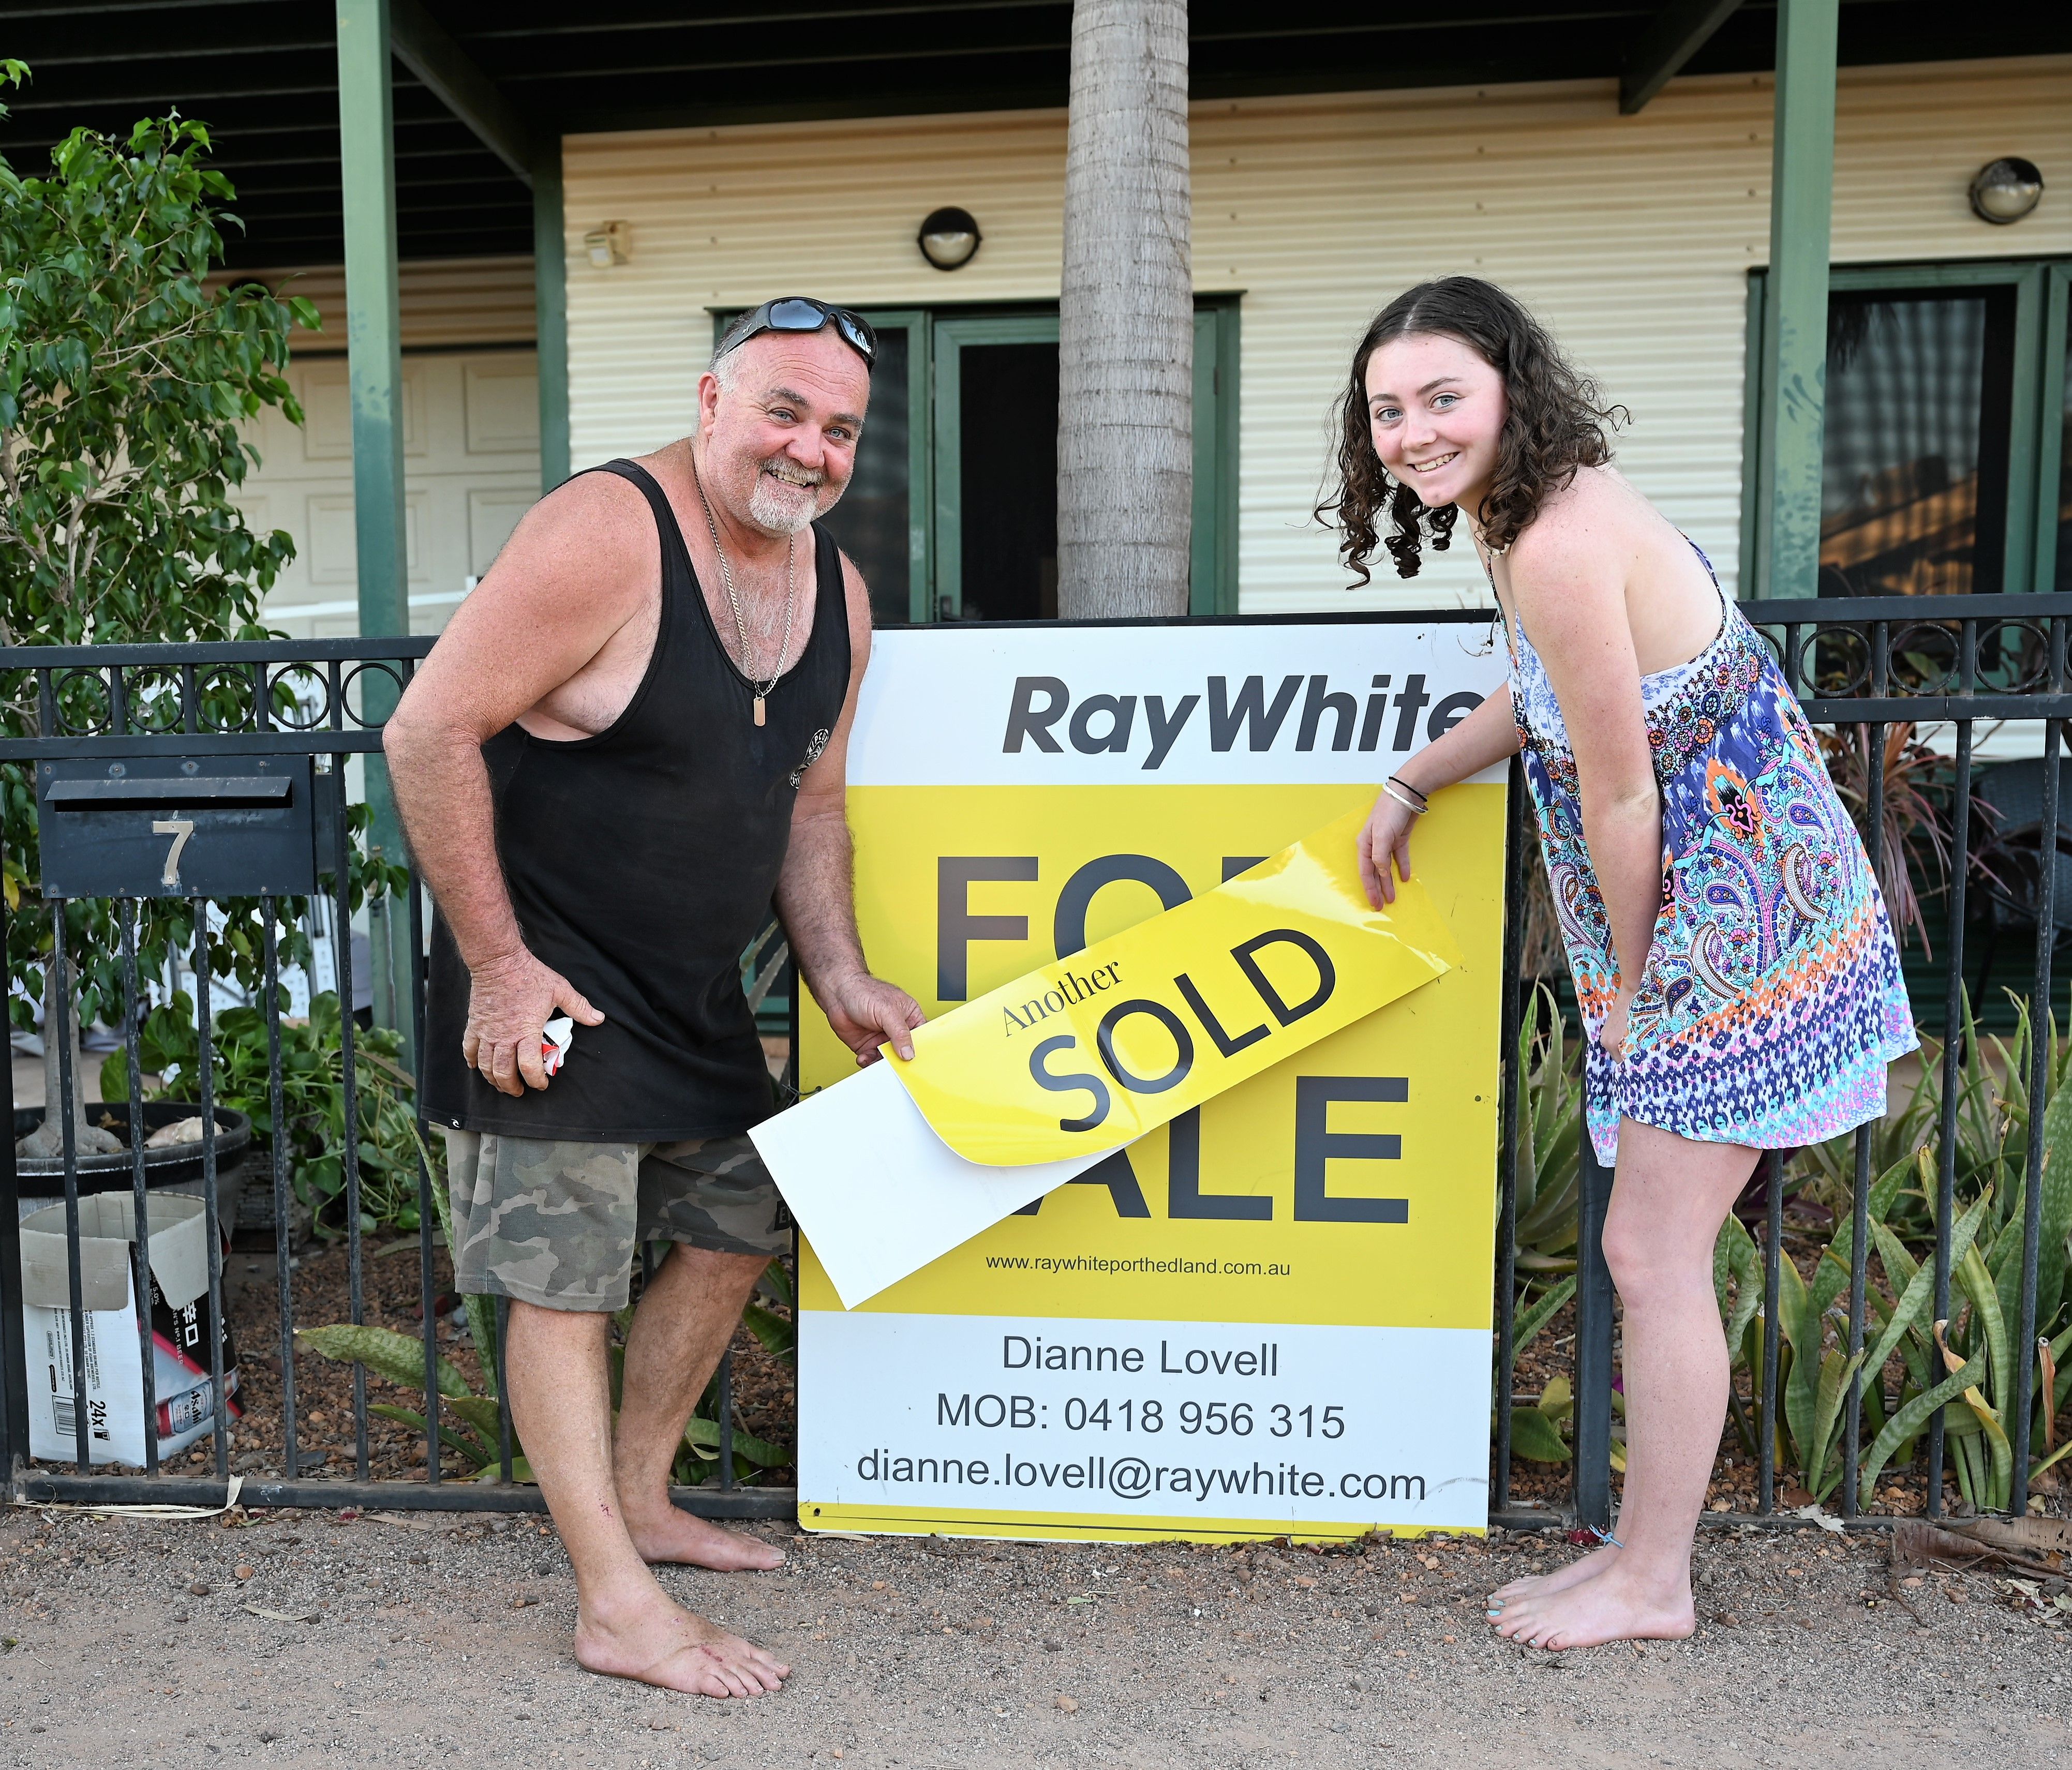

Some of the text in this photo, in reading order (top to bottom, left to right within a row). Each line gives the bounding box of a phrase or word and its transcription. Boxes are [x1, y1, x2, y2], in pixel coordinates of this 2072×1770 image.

[153, 820, 194, 884] 7
[937, 854, 1271, 1002] FO
[1003, 962, 1123, 1037] Another
[1029, 929, 1336, 1132] SOLD
[986, 1255, 1290, 1276] www.raywhiteporthedland.com.au
[1004, 1336, 1277, 1376] Dianne Lovell
[90, 1400, 107, 1427] 24x
[190, 1390, 202, 1424] Asahi
[938, 1393, 1345, 1439] MOB: 0418 956 315
[858, 1448, 1425, 1502] dianne.lovell@raywhite.com
